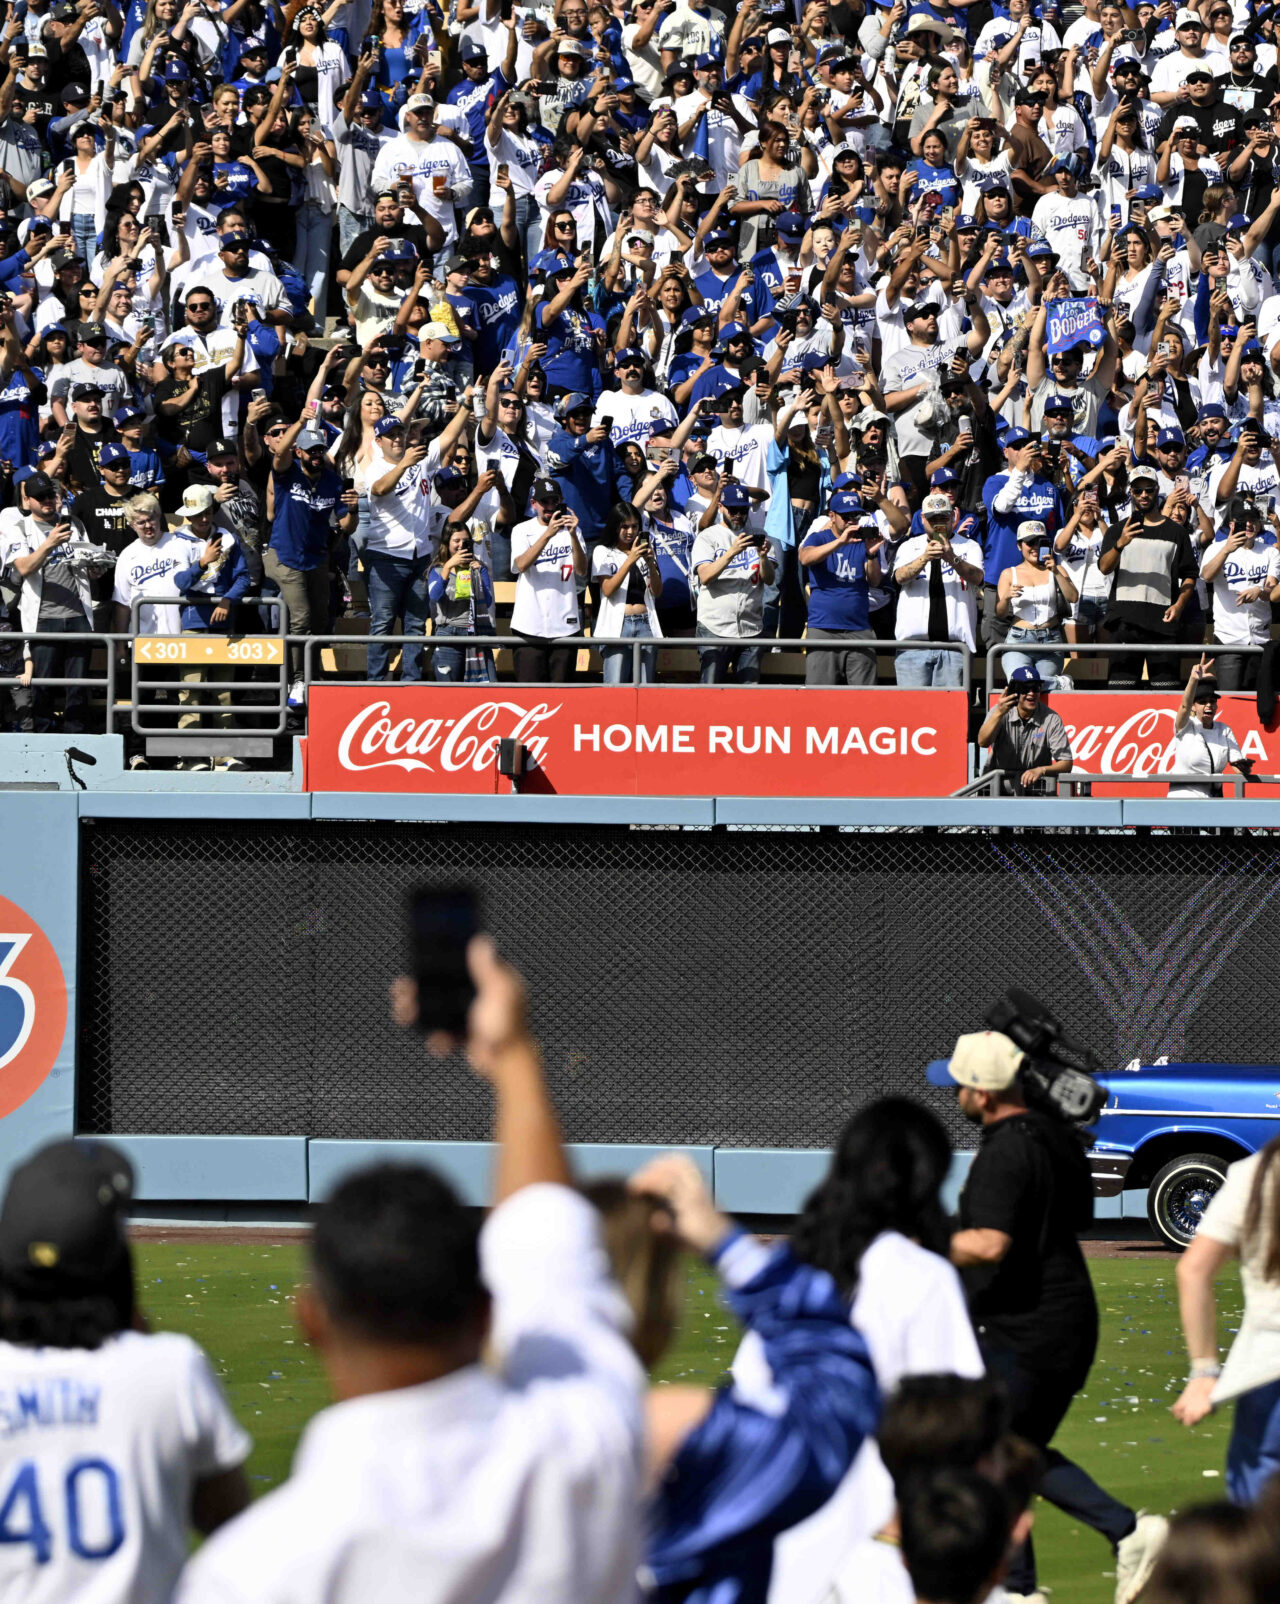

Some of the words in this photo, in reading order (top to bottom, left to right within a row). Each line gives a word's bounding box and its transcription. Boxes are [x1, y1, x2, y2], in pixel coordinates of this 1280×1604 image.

[1213, 118, 1235, 137] dgers
[1053, 213, 1090, 231] Dodgers
[1057, 299, 1086, 317] VIVA
[1064, 307, 1079, 317] LOS
[1051, 313, 1101, 345] DODGER
[710, 439, 758, 464] Dodgers
[1018, 494, 1054, 514] odgers
[131, 557, 172, 584] Dodge
[560, 564, 573, 581] 17
[835, 553, 856, 582] LA
[155, 642, 187, 659] 301
[227, 643, 263, 660] 303
[338, 701, 563, 772] Coca-Cola
[573, 724, 695, 753] HOME
[709, 725, 791, 754] RUN
[806, 726, 937, 756] MAGIC
[1243, 730, 1268, 760] A
[1, 1379, 102, 1434] SMITH
[0, 1458, 126, 1564] 40
